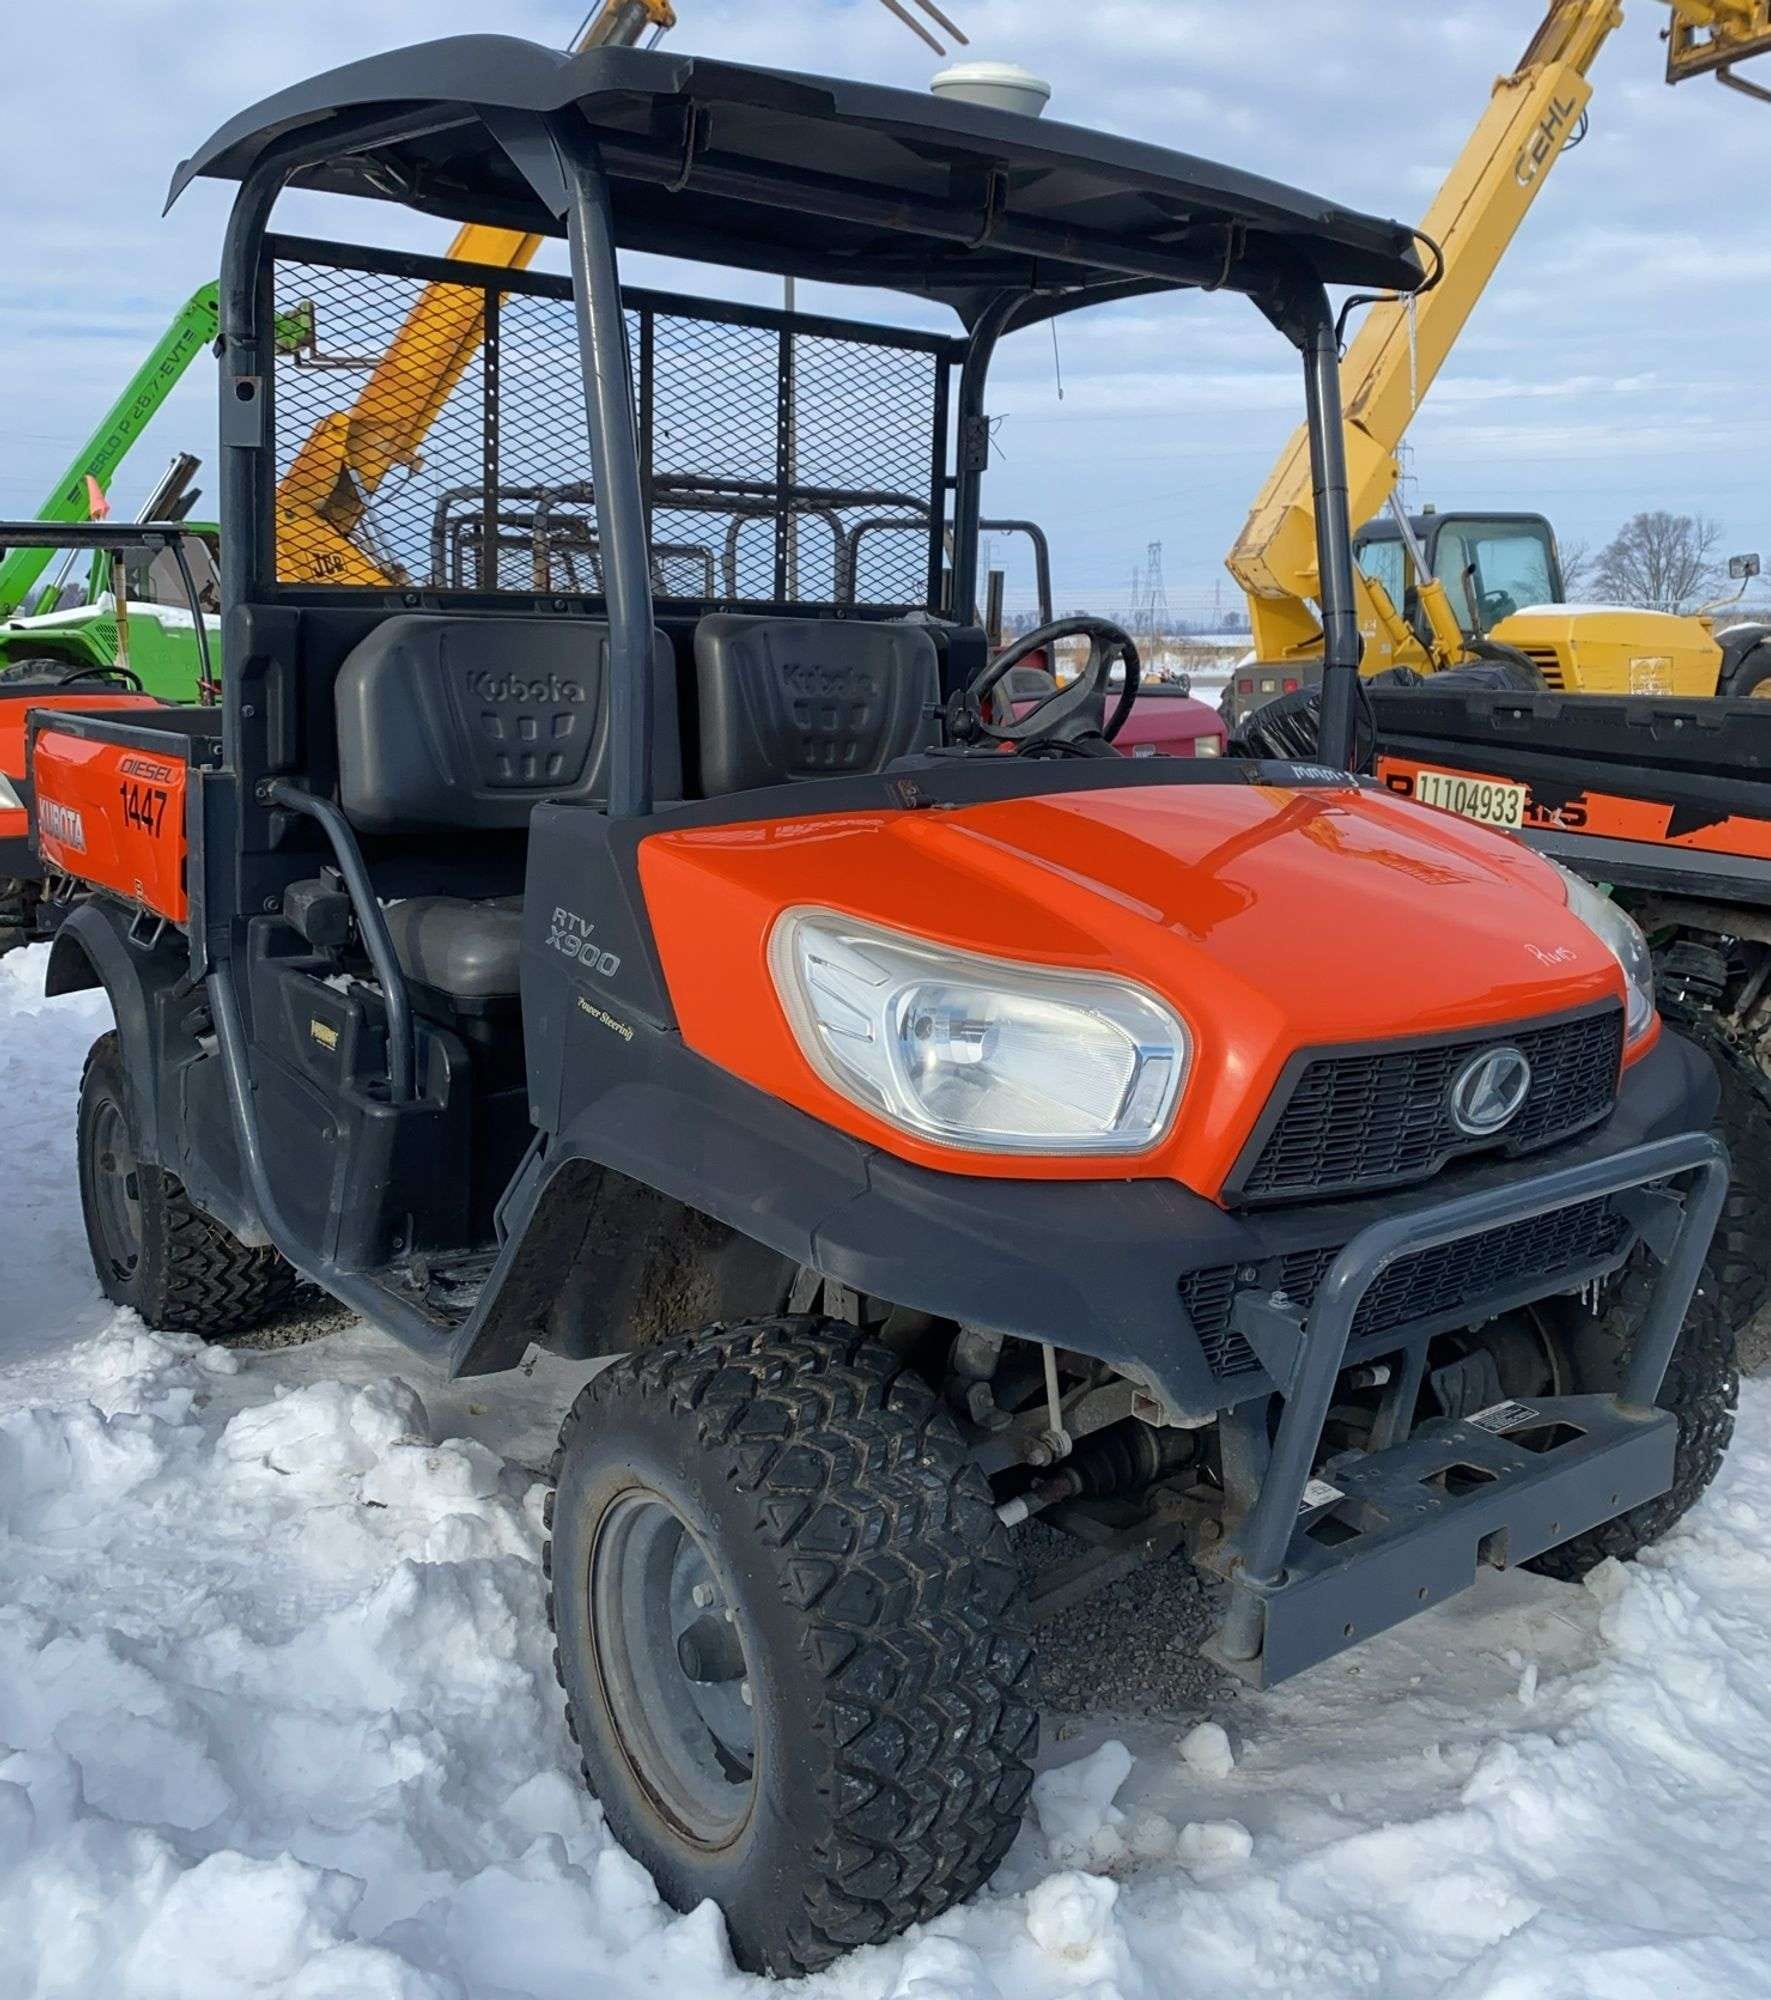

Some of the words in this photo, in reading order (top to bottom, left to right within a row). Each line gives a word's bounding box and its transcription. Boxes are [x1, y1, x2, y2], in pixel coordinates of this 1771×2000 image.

[84, 434, 122, 481] ERLO
[466, 670, 585, 702] Kubota
[119, 758, 174, 784] DIESEL
[38, 796, 85, 849] KUBOTA
[119, 780, 168, 838] 1447
[1420, 775, 1520, 824] 11104933
[552, 906, 595, 938] RTV
[545, 925, 621, 977] X900
[576, 996, 601, 1018] Power
[599, 1011, 634, 1041] Steering
